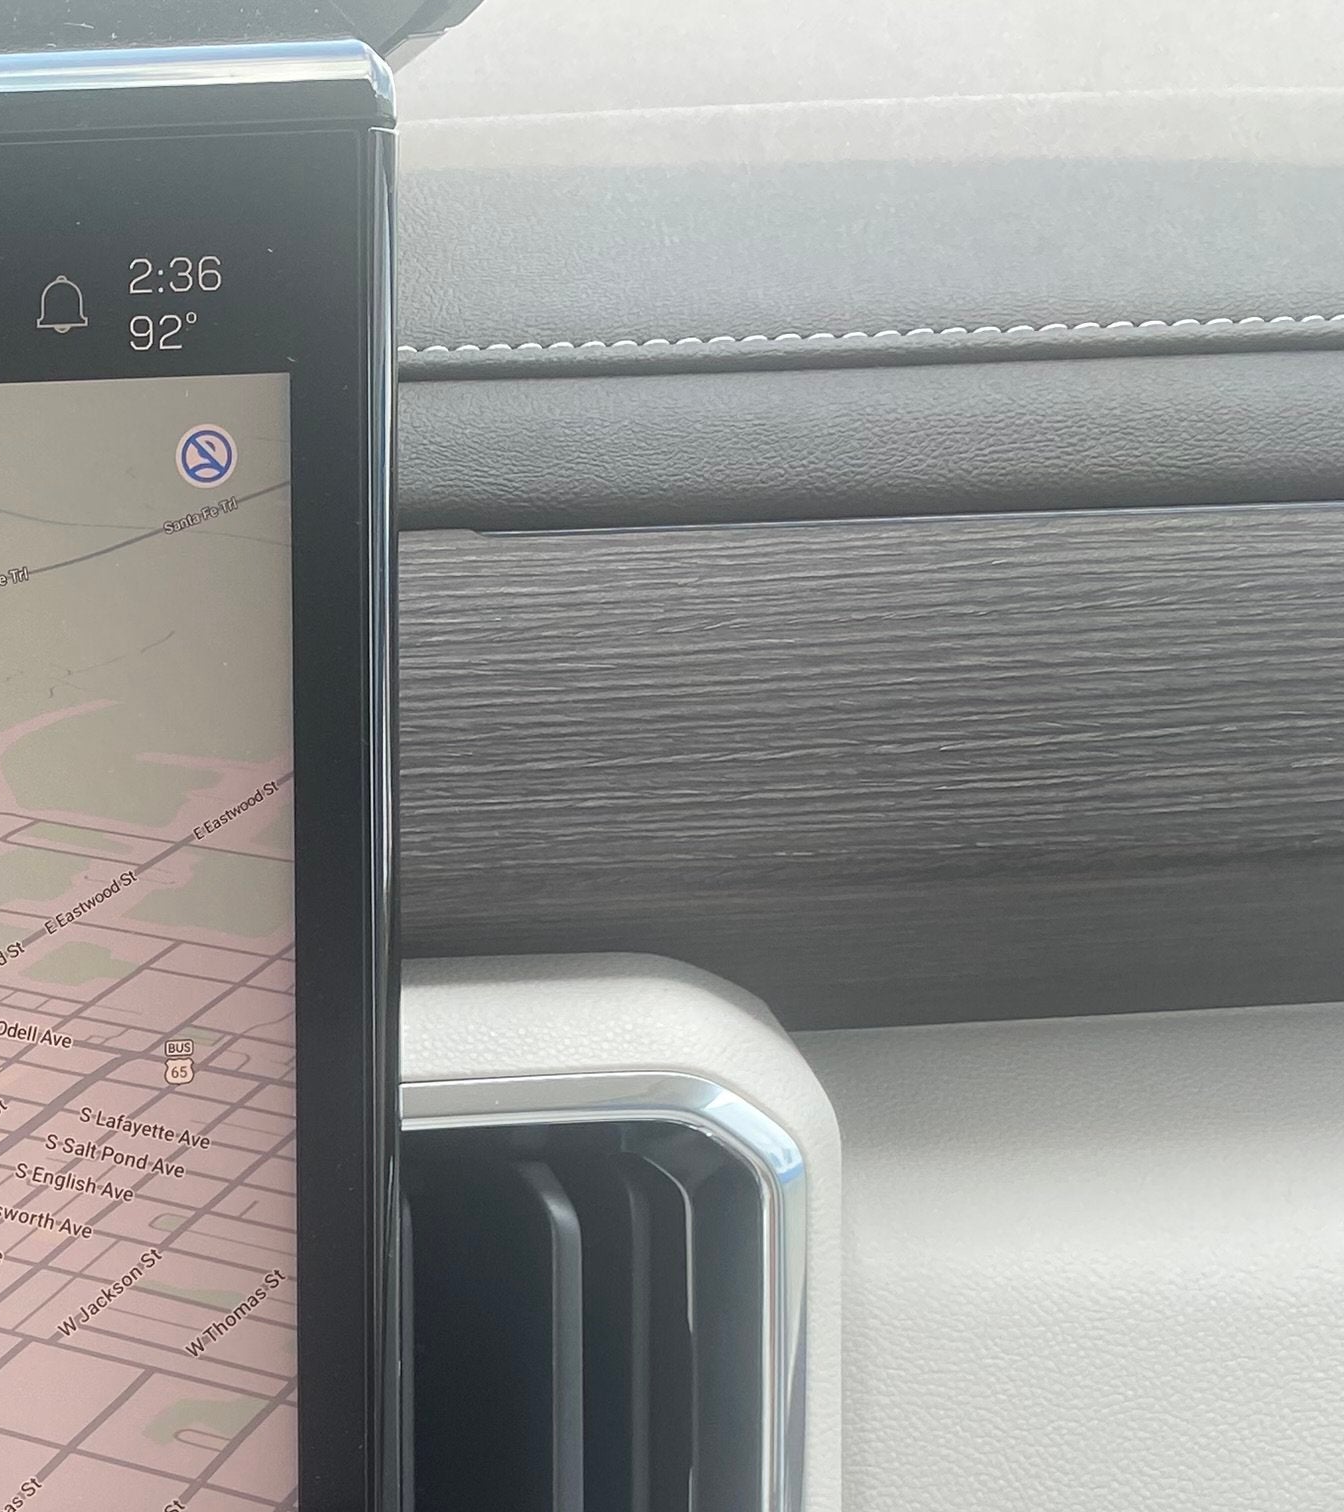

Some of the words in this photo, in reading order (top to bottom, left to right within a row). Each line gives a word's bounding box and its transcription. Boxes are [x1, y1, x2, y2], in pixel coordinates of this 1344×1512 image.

[128, 257, 222, 294] 2:36
[9, 567, 29, 582] Trl
[193, 825, 205, 840] E
[203, 790, 265, 834] Eastwood
[263, 781, 279, 797] St
[168, 1043, 191, 1053] BUS
[171, 1065, 188, 1078] 65
[80, 1107, 92, 1122] S
[96, 1111, 174, 1141] Lafayette
[178, 1130, 210, 1149] Ave
[45, 1134, 58, 1150] S
[63, 1138, 97, 1159] Salt
[101, 1148, 148, 1170] Pond
[151, 1159, 185, 1178] Ave
[185, 1339, 206, 1358] W
[203, 1287, 268, 1342] Thomas
[264, 1268, 286, 1289] St
